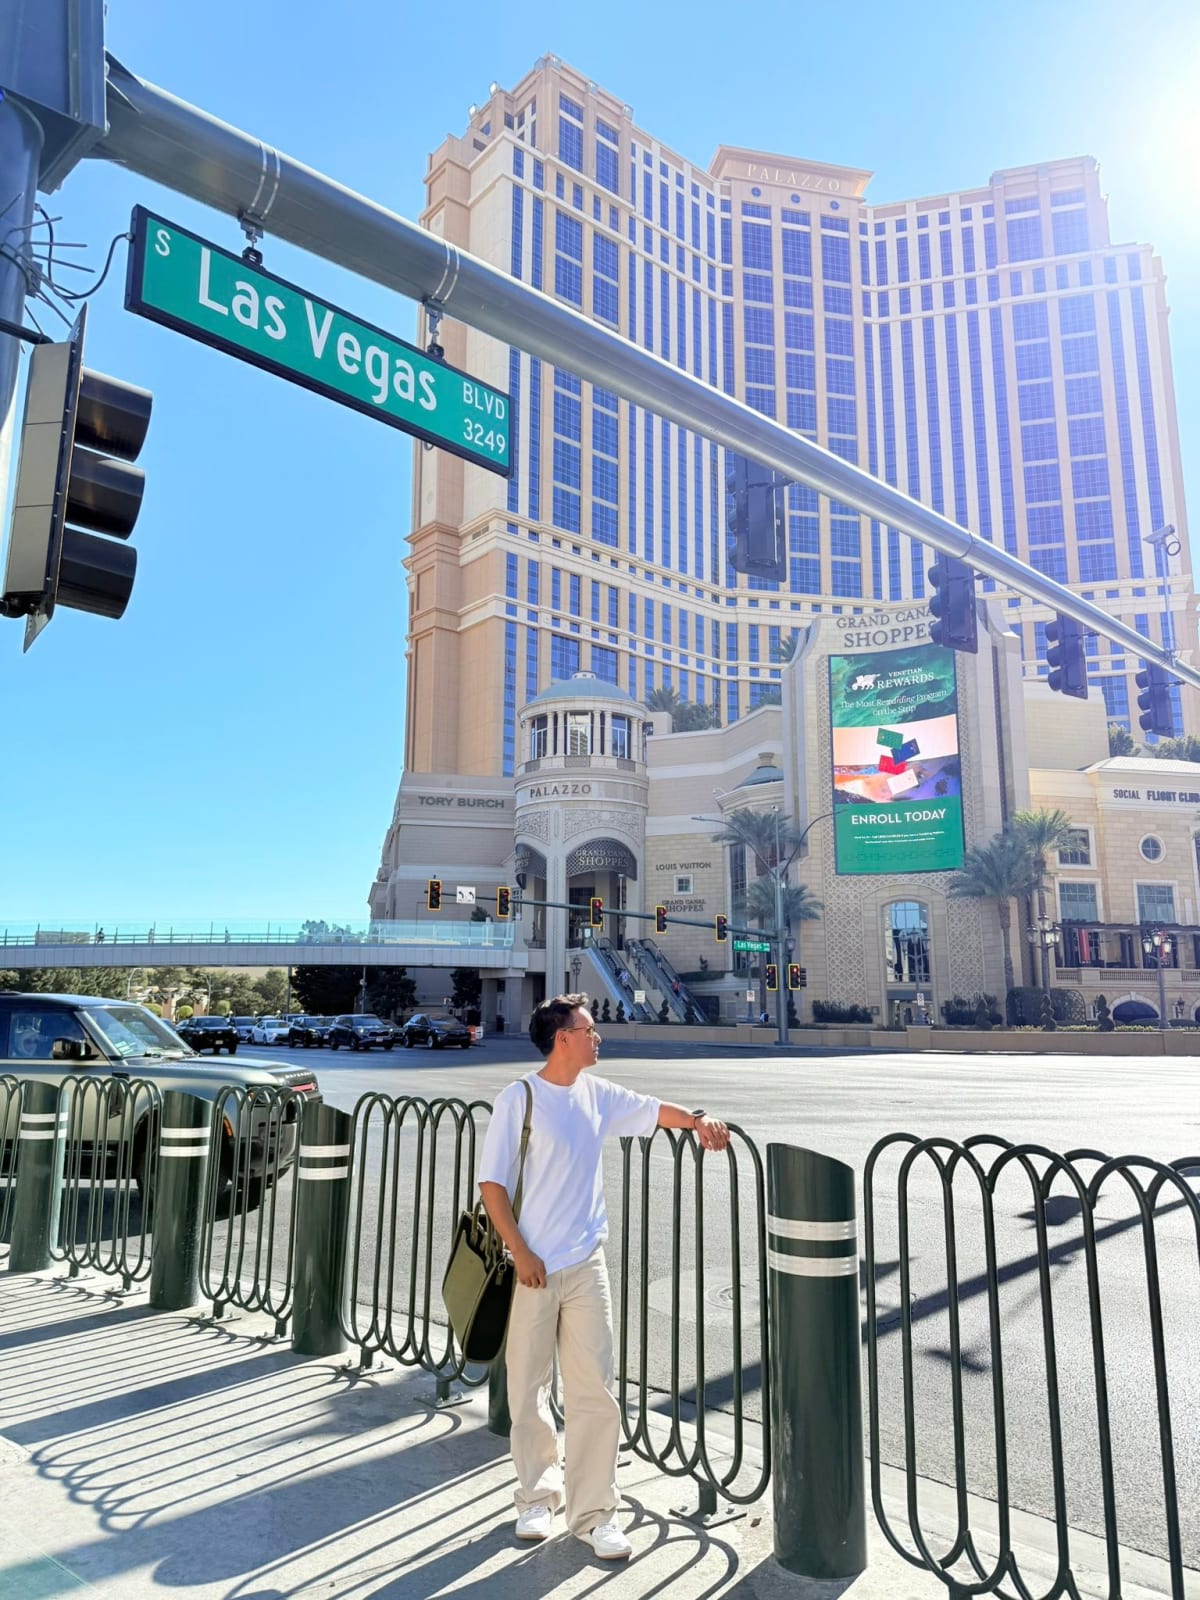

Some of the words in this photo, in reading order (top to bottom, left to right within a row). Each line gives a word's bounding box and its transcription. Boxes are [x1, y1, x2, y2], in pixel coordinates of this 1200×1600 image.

[747, 163, 840, 192] PALAZZO
[154, 228, 171, 257] S
[199, 246, 287, 341] Las
[304, 299, 437, 412] Vegas
[462, 381, 506, 421] BLVD
[463, 419, 506, 455] 3249
[836, 613, 890, 629] GRAND
[888, 667, 923, 678] VENETIAN
[877, 672, 935, 689] REWARDS
[856, 700, 875, 708] Most
[529, 783, 592, 799] PALAZZO
[1113, 789, 1141, 800] SOCIAL
[1146, 789, 1177, 802] FLIGHT
[418, 795, 452, 807] TORY
[457, 797, 505, 809] BURCH
[851, 813, 902, 825] ENROLL
[904, 808, 947, 822] TODAY
[575, 849, 606, 857] GRAND
[578, 856, 629, 867] SHOPPES
[656, 863, 677, 871] LOUIS
[680, 862, 711, 870] VUITTON
